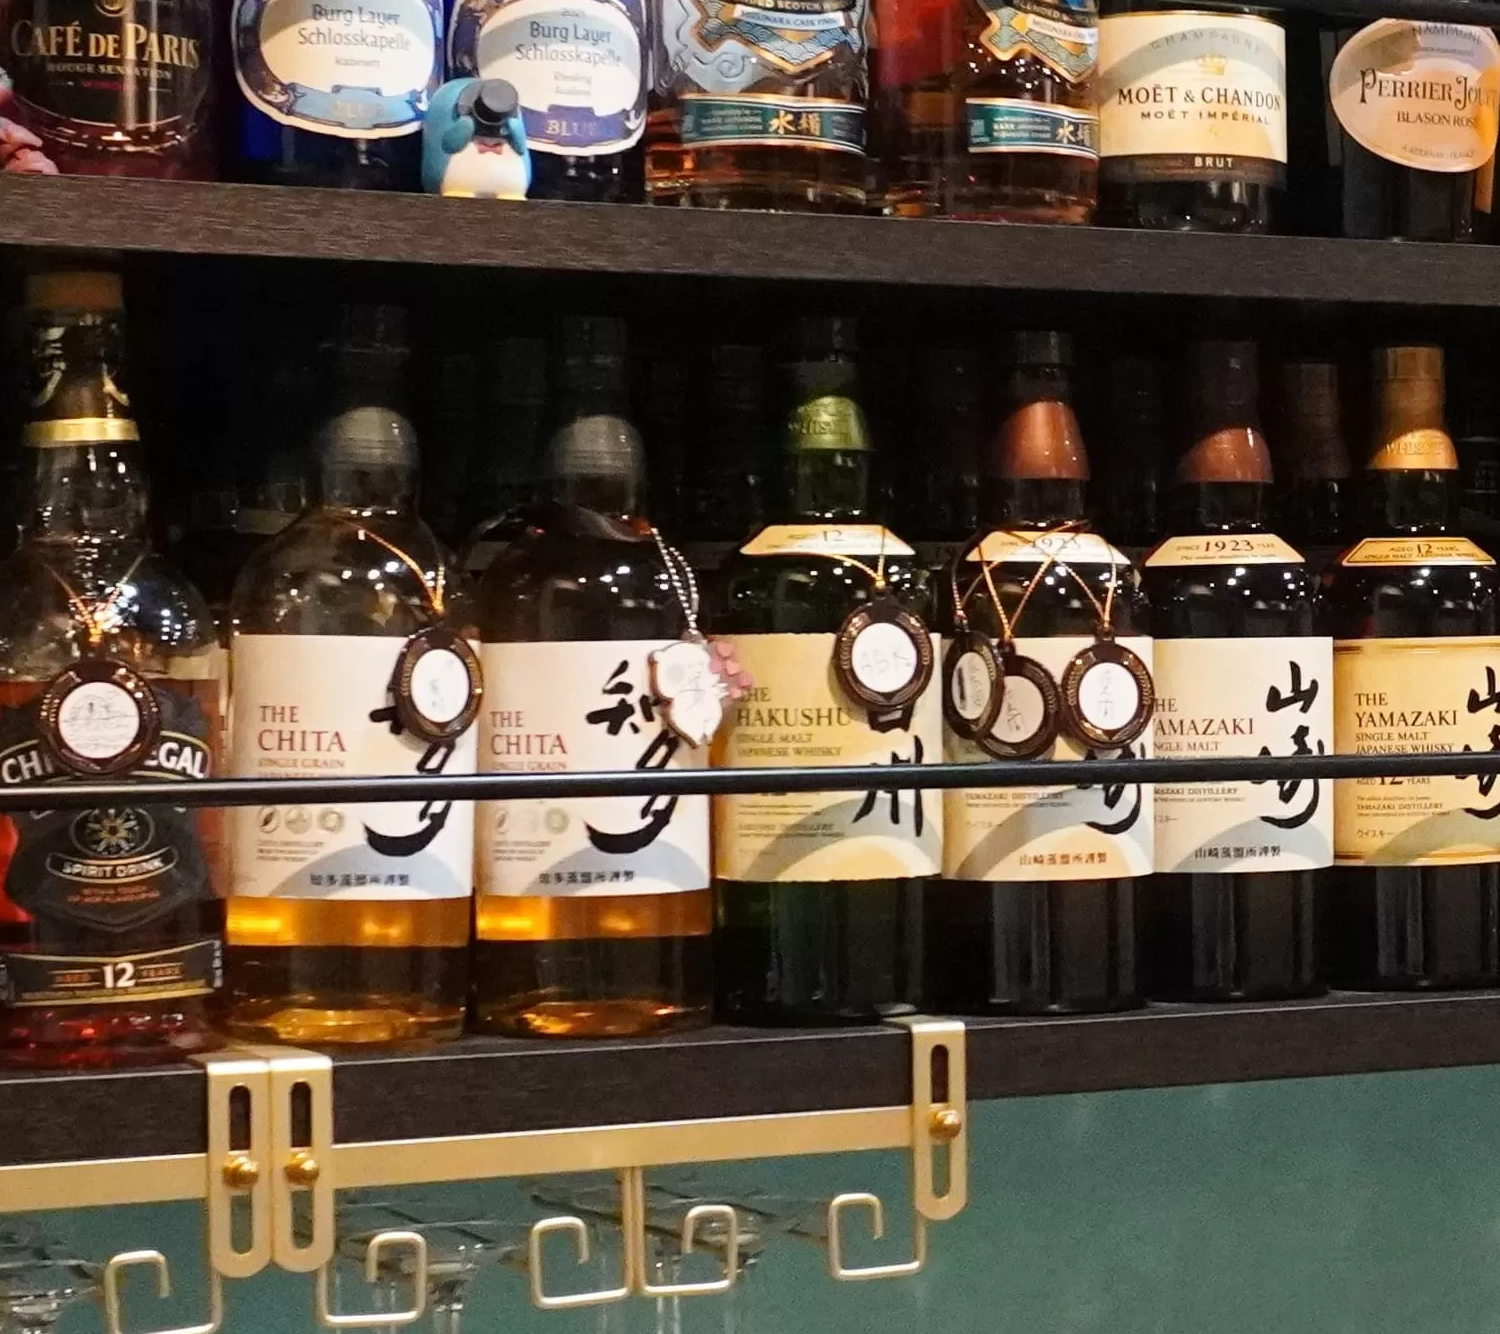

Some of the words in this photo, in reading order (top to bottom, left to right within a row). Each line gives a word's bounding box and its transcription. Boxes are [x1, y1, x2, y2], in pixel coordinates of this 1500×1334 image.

[311, 3, 354, 26] Burg
[358, 6, 401, 30] Layer
[297, 27, 412, 52] Schlosskapelle
[529, 20, 570, 43] Burg
[573, 23, 612, 47] Layer
[11, 20, 83, 58] CAFÉ
[88, 32, 120, 57] DE
[122, 23, 200, 69] PARIS
[515, 43, 623, 68] Schlosskapelle
[1117, 83, 1178, 106] MOËT
[1183, 89, 1197, 104] &
[1201, 86, 1281, 111] CHANDON
[1140, 108, 1189, 120] MOËT
[1198, 110, 1271, 125] IMPÉRIAL
[1396, 110, 1451, 126] BLASON
[1194, 156, 1235, 169] BRUT
[1202, 538, 1255, 553] 1923
[1416, 542, 1433, 555] 12
[1353, 691, 1389, 707] THE
[259, 704, 299, 724] THE
[489, 710, 524, 729] THE
[737, 707, 852, 727] HAKUSHU
[1354, 709, 1459, 729] YAMAZAKI
[257, 729, 348, 753] CHITA
[490, 733, 569, 756] CHITA
[1354, 731, 1395, 742] SINGLE
[1397, 730, 1429, 742] MALT
[791, 745, 842, 758] WHISKY
[1186, 741, 1220, 752] MALT
[1354, 744, 1409, 755] JAPANESE
[1410, 742, 1455, 754] WHISKY
[301, 757, 346, 768] GRAIN
[1187, 786, 1238, 796] DISTILLERY
[1355, 801, 1397, 811] YAMAZAKI
[1397, 801, 1444, 810] DISTILLERY
[61, 860, 115, 878] SPIRIT
[115, 856, 165, 878] DRINK
[101, 962, 137, 989] 12
